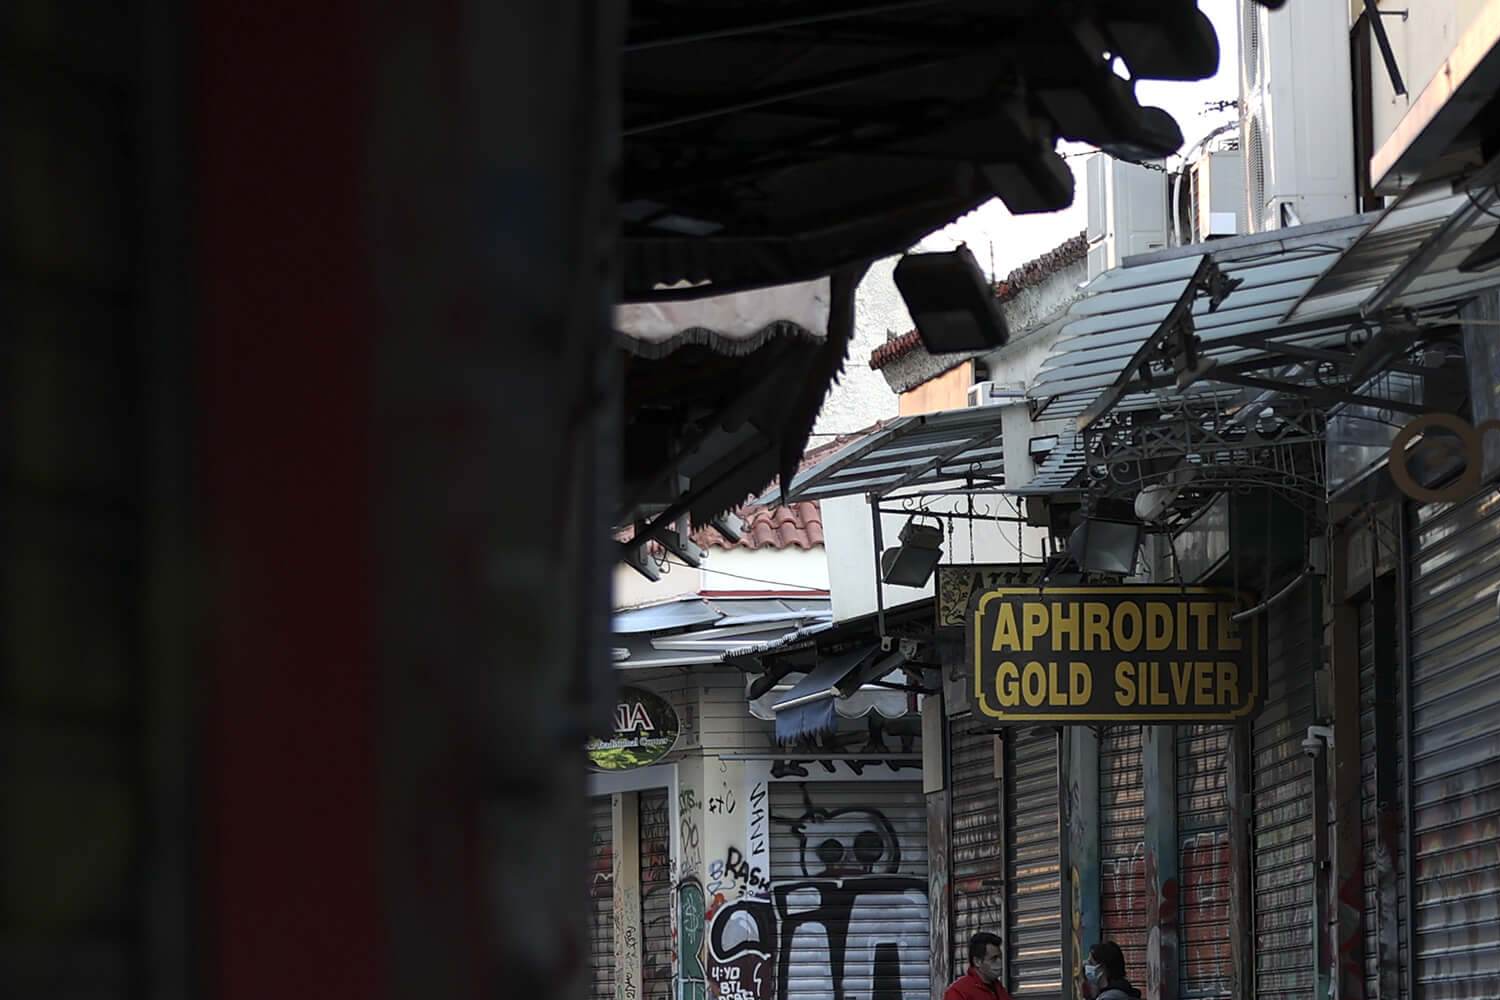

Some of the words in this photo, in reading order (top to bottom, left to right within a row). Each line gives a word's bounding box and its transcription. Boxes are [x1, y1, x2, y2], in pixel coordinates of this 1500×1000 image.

[991, 600, 1242, 652] APHRODITE
[995, 660, 1094, 707] GOLD
[1114, 660, 1241, 707] SILVER
